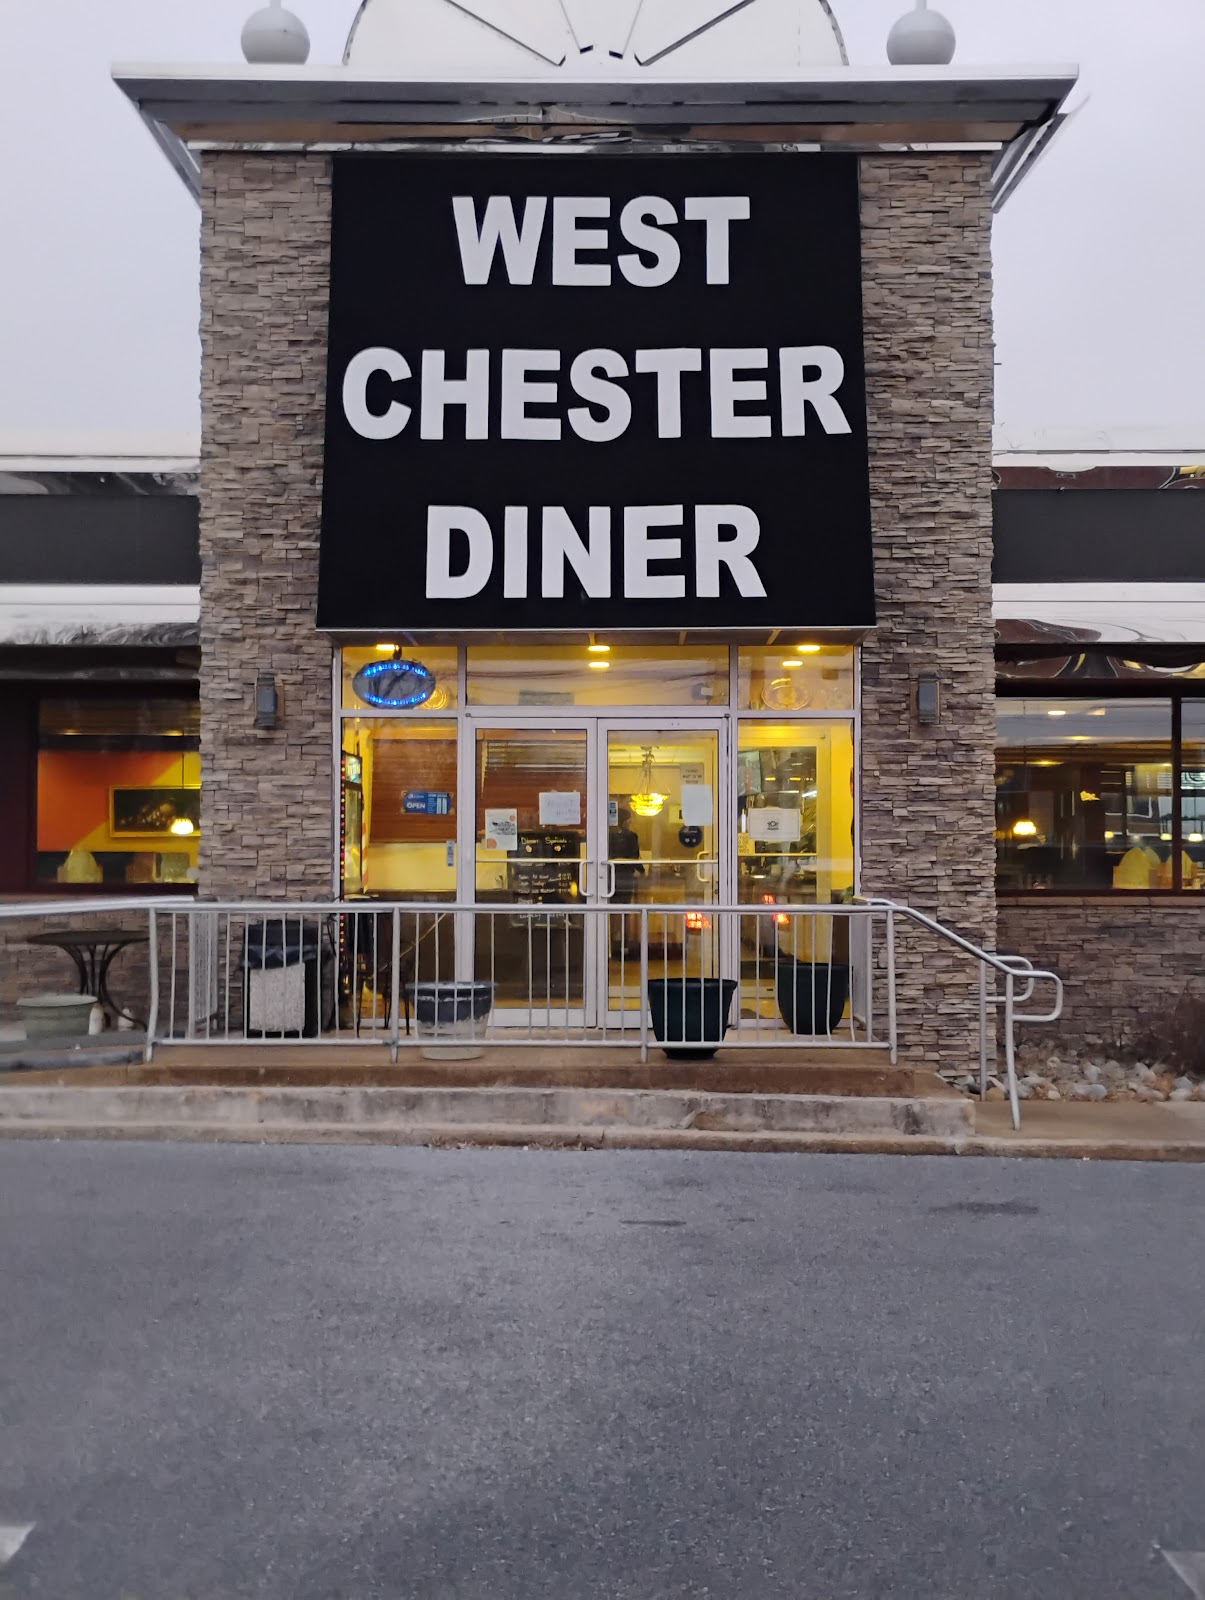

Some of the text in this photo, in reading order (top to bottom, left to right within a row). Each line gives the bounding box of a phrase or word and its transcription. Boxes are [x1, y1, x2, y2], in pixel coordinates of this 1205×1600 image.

[453, 196, 750, 287] WEST
[343, 346, 852, 441] CHESTER
[426, 505, 767, 599] DINER
